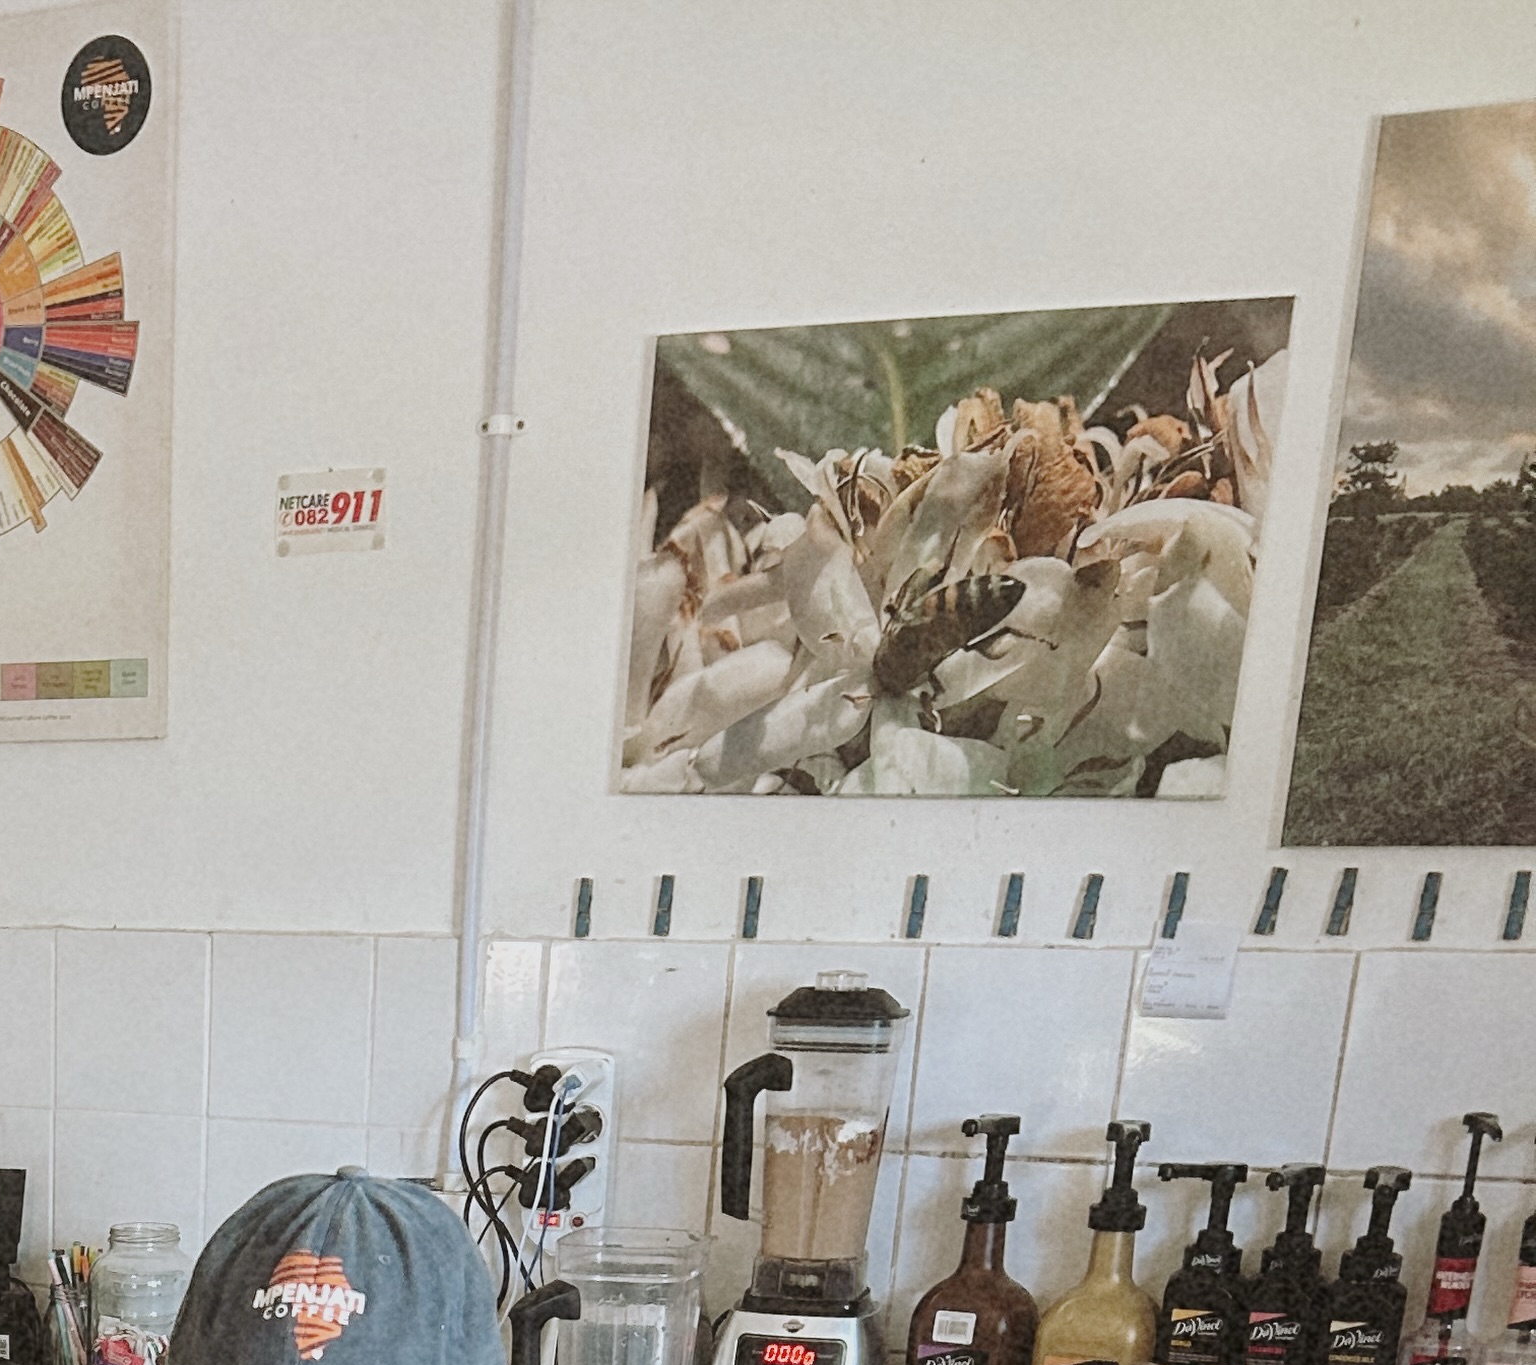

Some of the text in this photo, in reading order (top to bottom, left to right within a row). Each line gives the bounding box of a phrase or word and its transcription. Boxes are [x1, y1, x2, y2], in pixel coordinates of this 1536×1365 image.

[73, 80, 139, 101] MPENJATI
[279, 493, 331, 511] NETCARE
[295, 489, 383, 526] 082 911
[252, 1282, 366, 1315] MPENJATI
[263, 1302, 350, 1326] COFFEE
[1172, 1316, 1224, 1337] DaVinci
[1249, 1321, 1302, 1341] DaVinci
[1331, 1329, 1385, 1350] DaVinci
